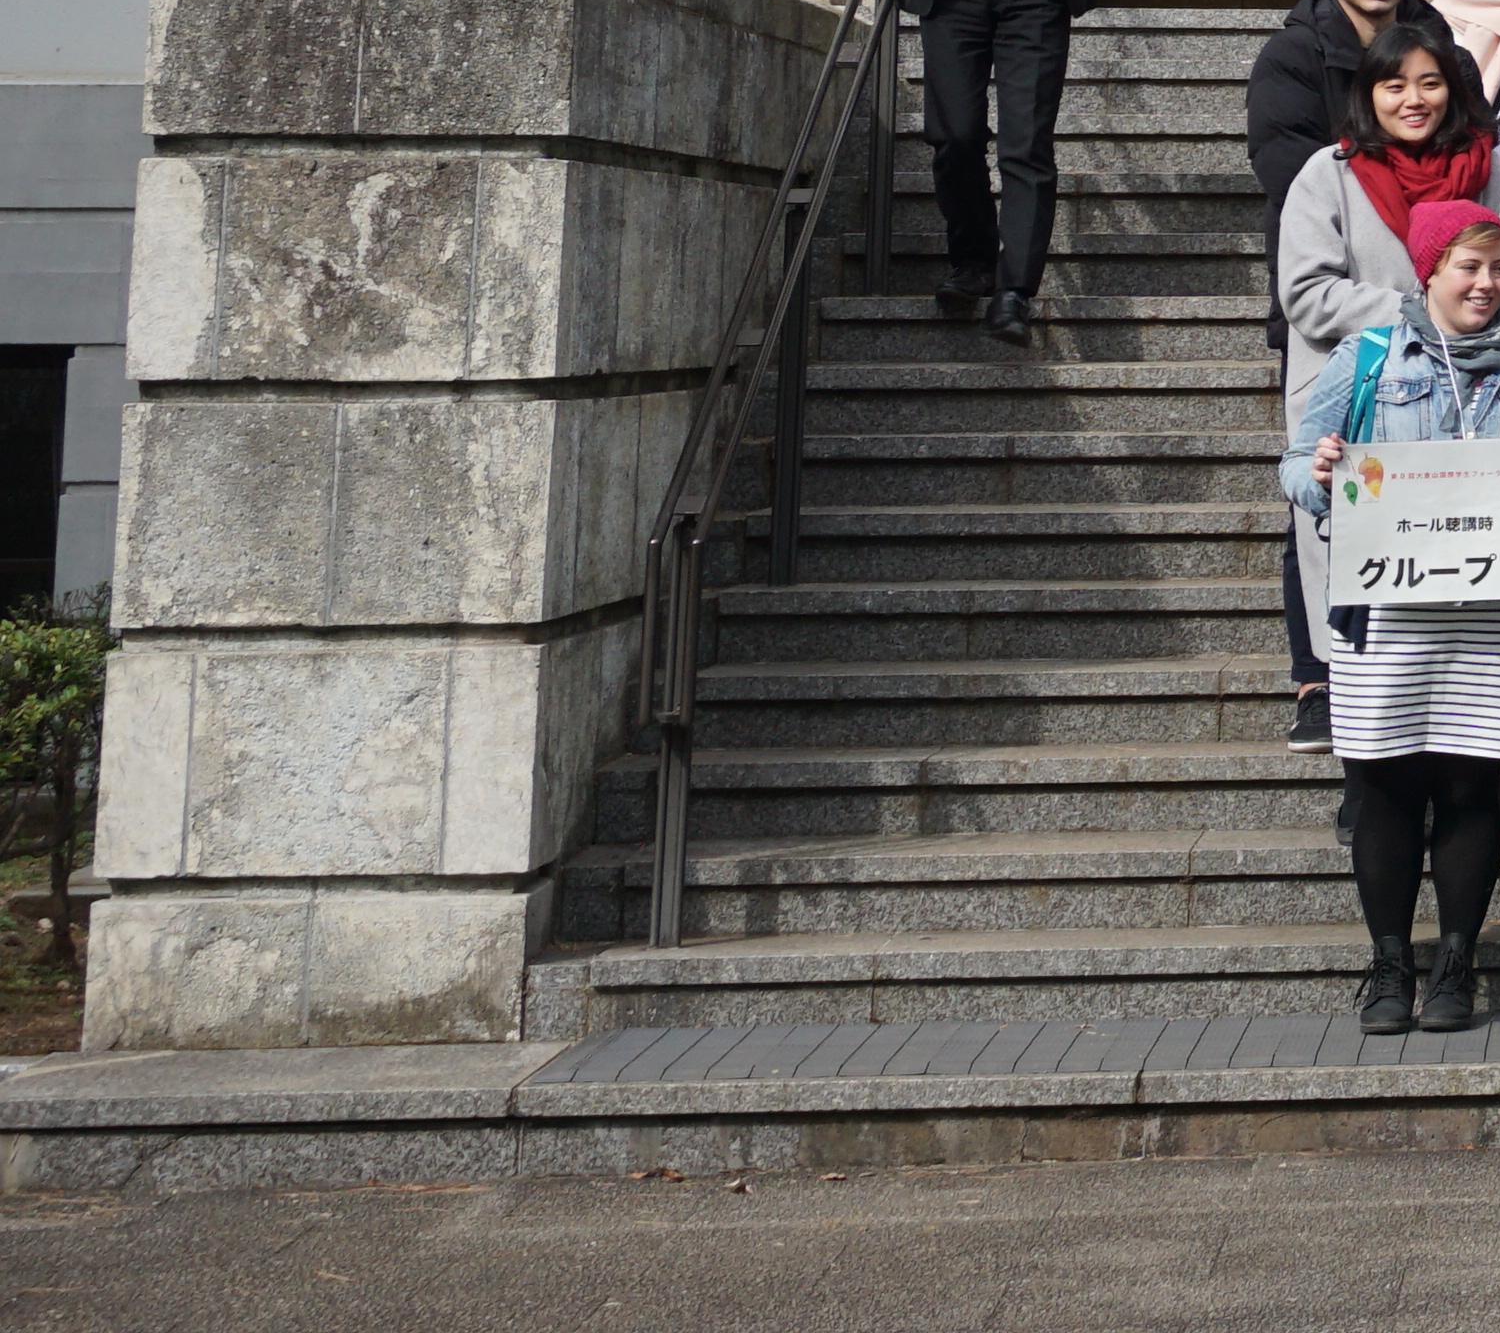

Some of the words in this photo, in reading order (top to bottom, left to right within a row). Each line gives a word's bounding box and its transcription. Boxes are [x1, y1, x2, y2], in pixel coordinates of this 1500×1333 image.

[1397, 516, 1493, 533] ホール聴講時
